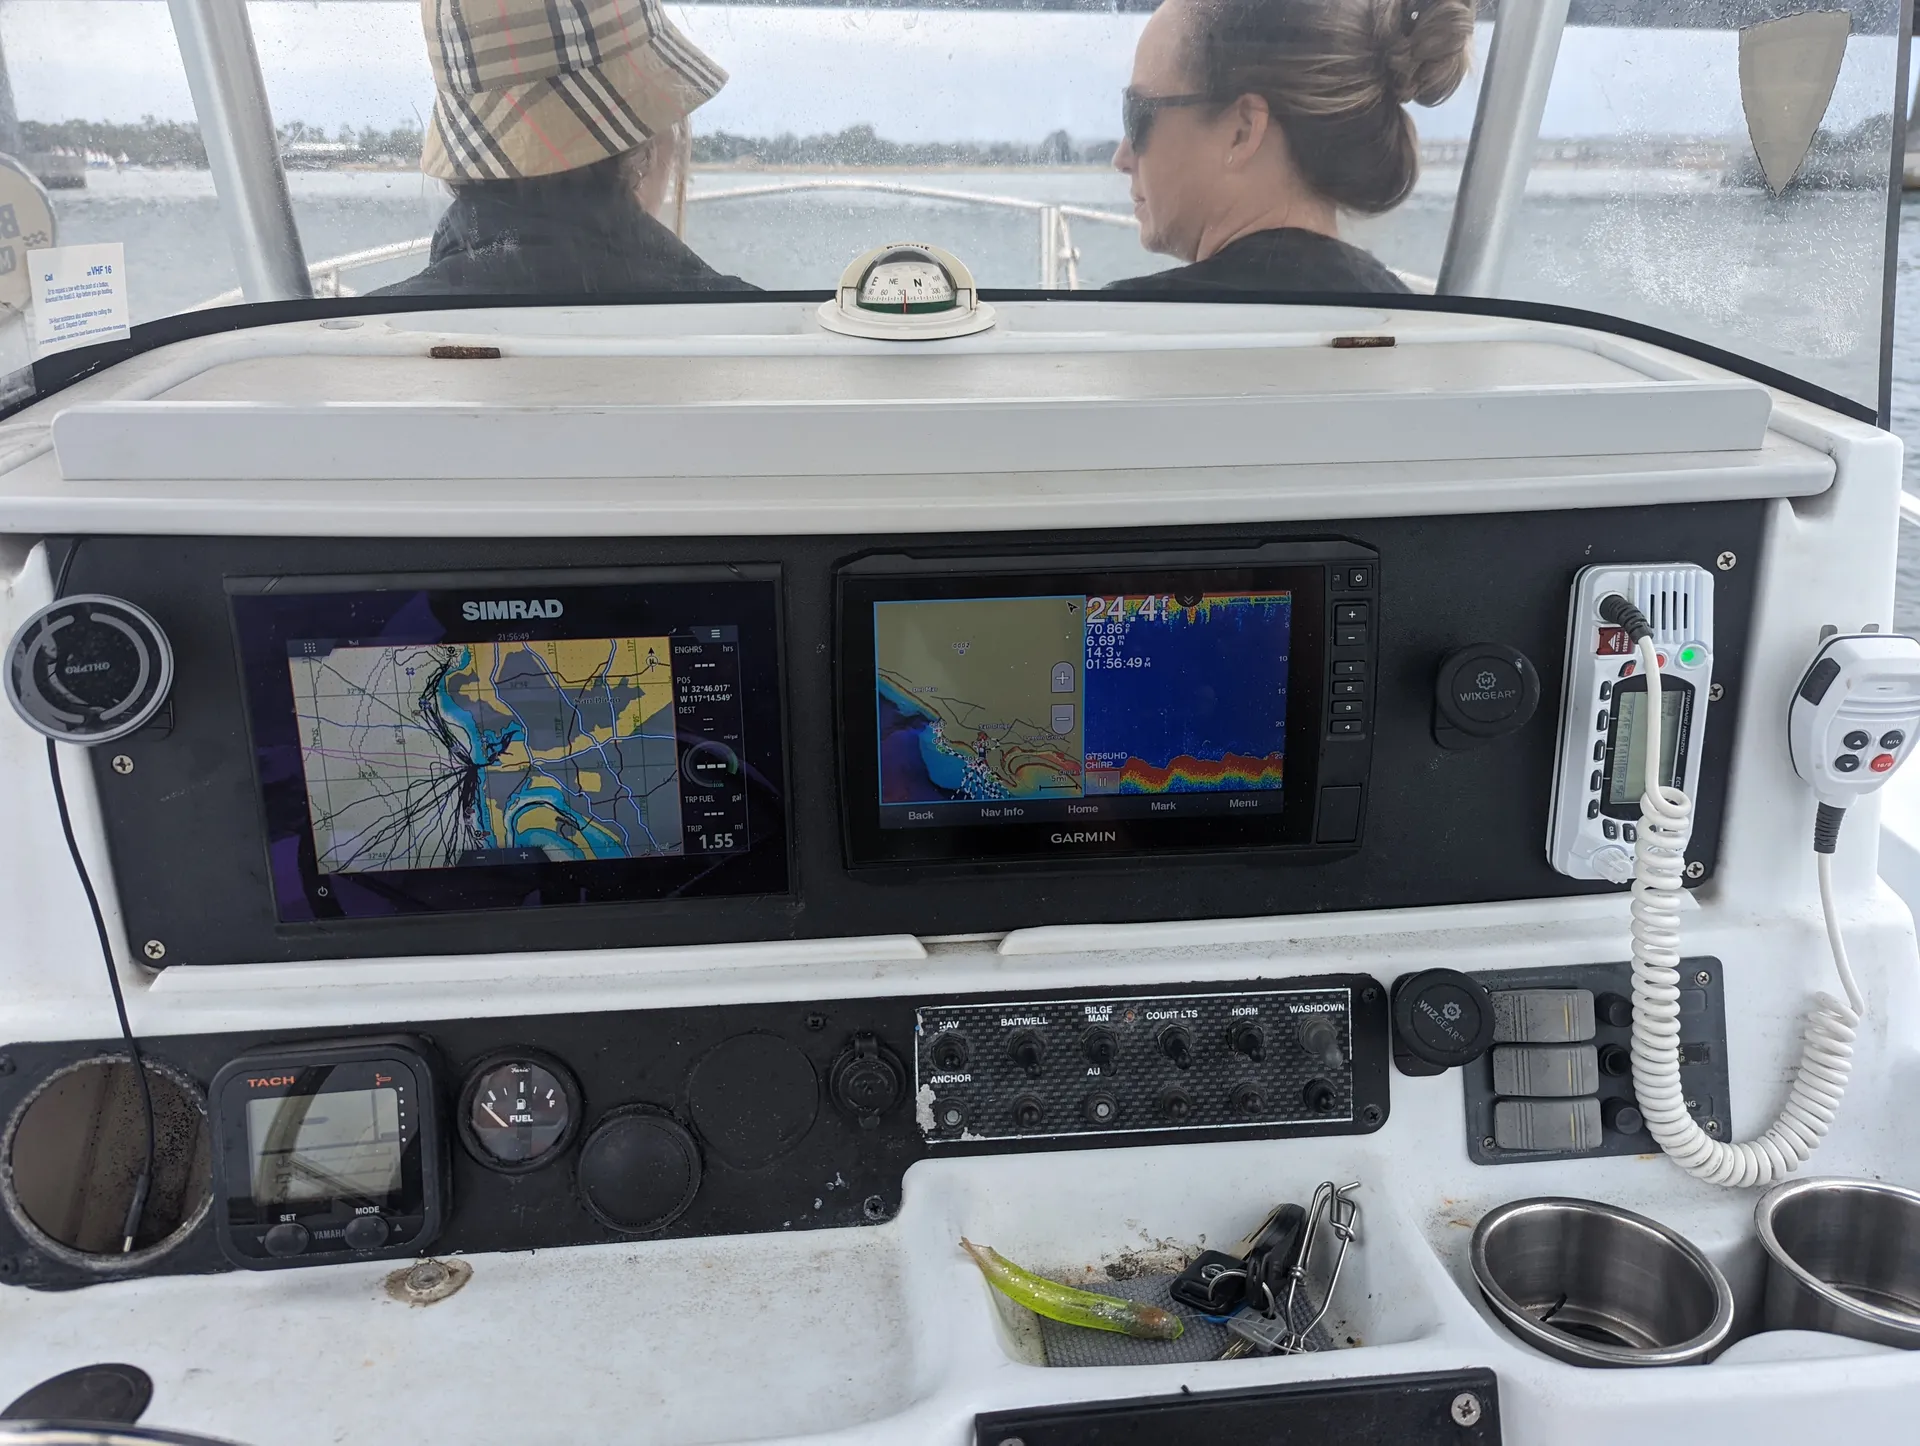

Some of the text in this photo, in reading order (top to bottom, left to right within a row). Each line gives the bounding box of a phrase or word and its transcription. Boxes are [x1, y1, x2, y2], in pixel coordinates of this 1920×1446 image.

[91, 265, 103, 275] VHF
[104, 265, 112, 274] 16
[913, 278, 922, 287] N
[462, 599, 564, 621] SIMRAD
[1087, 595, 1158, 623] 24.4
[1086, 623, 1123, 635] 70.86
[498, 632, 530, 641] 21:56:49
[1086, 635, 1116, 646] 6.69
[674, 644, 734, 654] ENGHRS hrs
[1086, 646, 1114, 658] 14.3
[1086, 657, 1143, 669] 01:56:49
[680, 695, 688, 703] W
[678, 706, 696, 714] DEST
[1680, 689, 1692, 756] STANDARD HORIZON
[1085, 751, 1128, 760] GT56UHD
[1085, 761, 1113, 769] CHIRP
[699, 794, 715, 802] FUEL
[732, 793, 742, 802] gal
[1151, 801, 1176, 811] Mark
[1229, 799, 1258, 808] Menu
[981, 807, 1024, 817] Nav Info
[1068, 804, 1099, 814] Home
[908, 810, 934, 820] Back
[699, 833, 734, 849] 1.55
[1050, 831, 1116, 844] GARMIN
[1084, 1006, 1113, 1015] BILGE
[1231, 1007, 1258, 1016] HORN
[1289, 1004, 1345, 1014] WASHDOWN
[1088, 1014, 1109, 1022] MAN
[1146, 1009, 1198, 1020] COURT LTS
[1000, 1017, 1048, 1027] BAITWELL
[1087, 1068, 1100, 1076] AU
[247, 1075, 296, 1088] TACH
[930, 1074, 971, 1084] ANCHOR
[487, 1102, 493, 1110] E
[549, 1100, 555, 1108] F
[509, 1114, 533, 1123] FUEL
[355, 1206, 380, 1215] MODE
[280, 1213, 296, 1222] SET
[313, 1228, 346, 1239] YAMAHA
